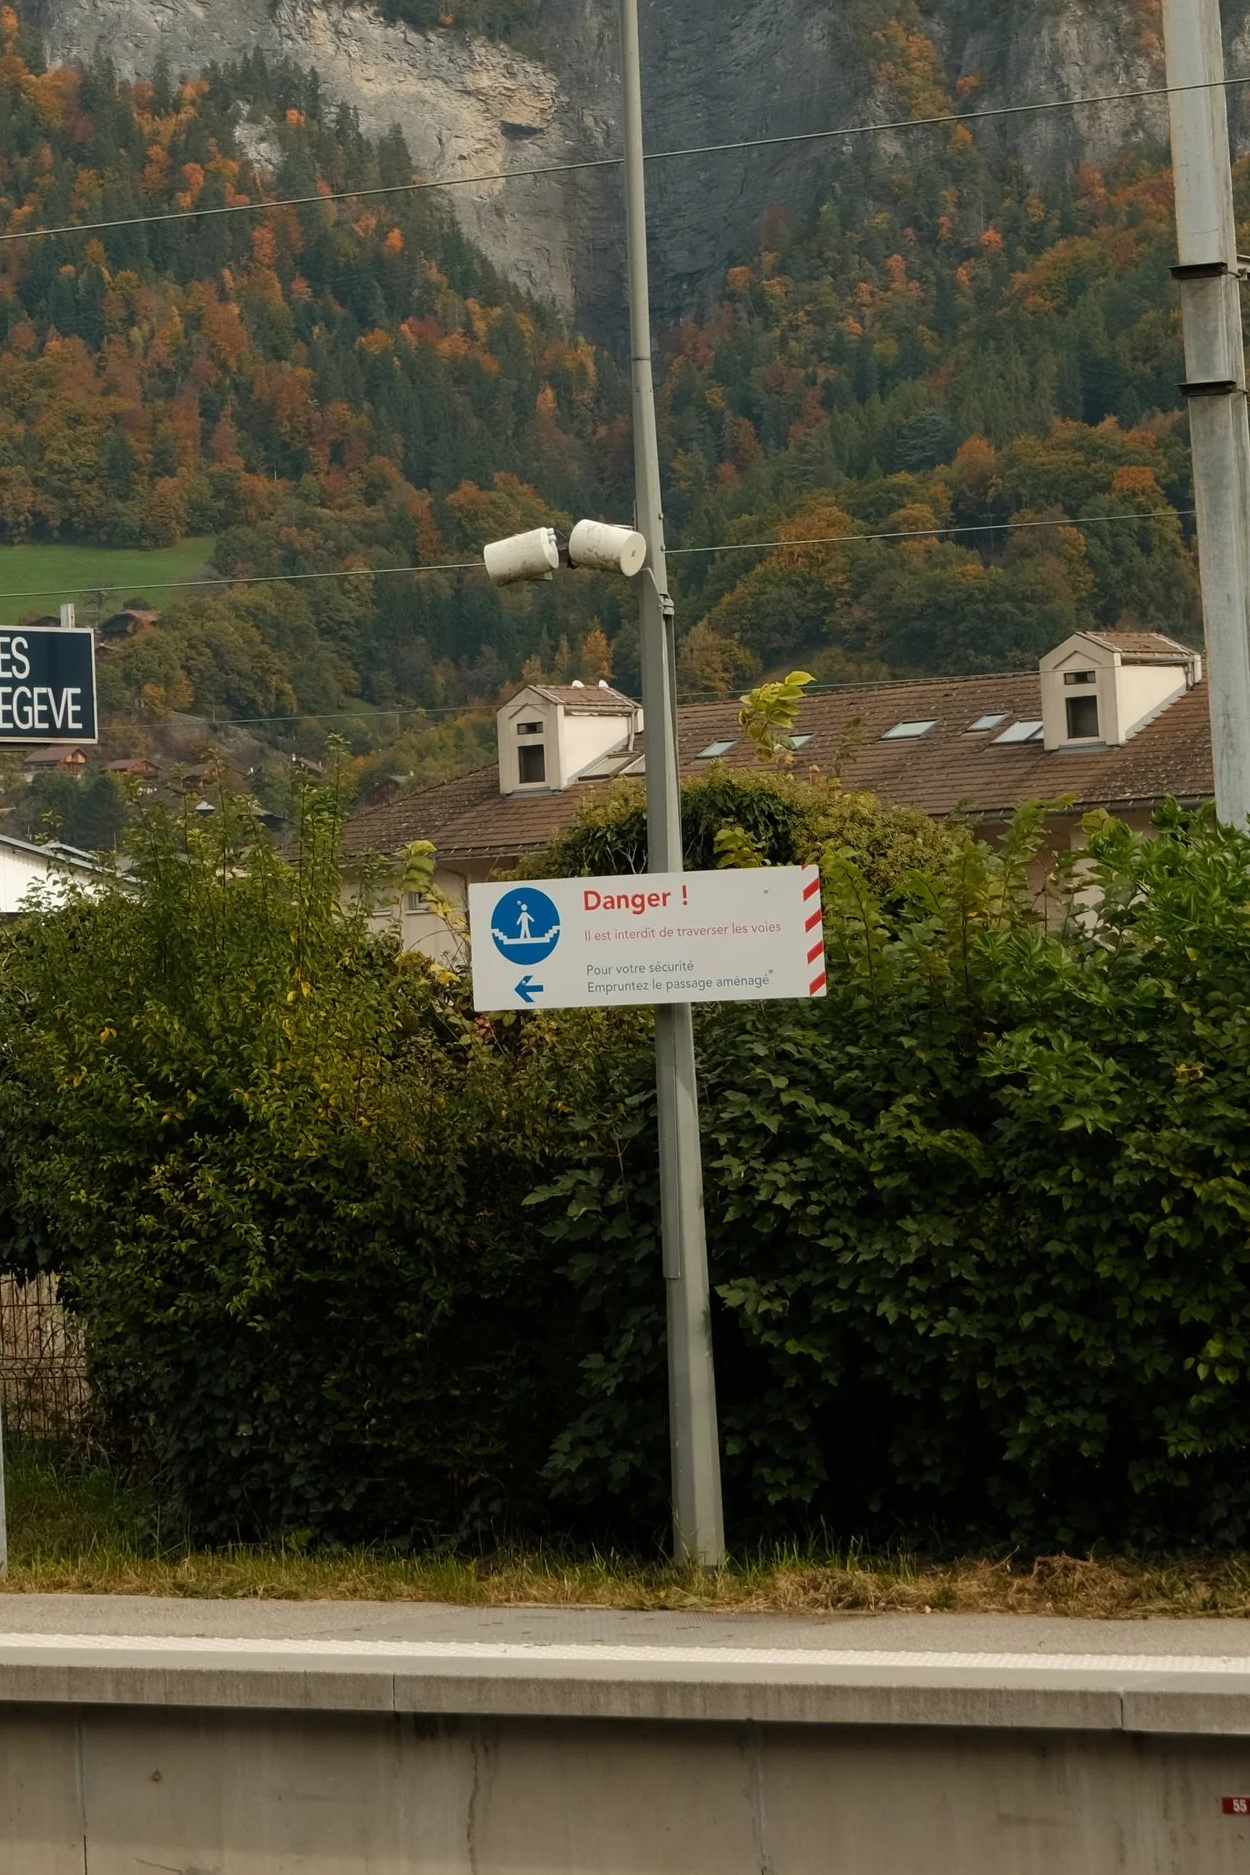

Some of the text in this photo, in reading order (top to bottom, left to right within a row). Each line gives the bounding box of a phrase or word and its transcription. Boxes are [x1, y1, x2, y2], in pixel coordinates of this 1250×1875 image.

[583, 885, 688, 915] Danger !
[584, 921, 781, 941] Il est interdit de traverser les voies
[587, 960, 694, 975] Pour votre sécurité
[587, 974, 769, 995] Empruntez le passage aménagé
[1233, 1799, 1247, 1813] 55
